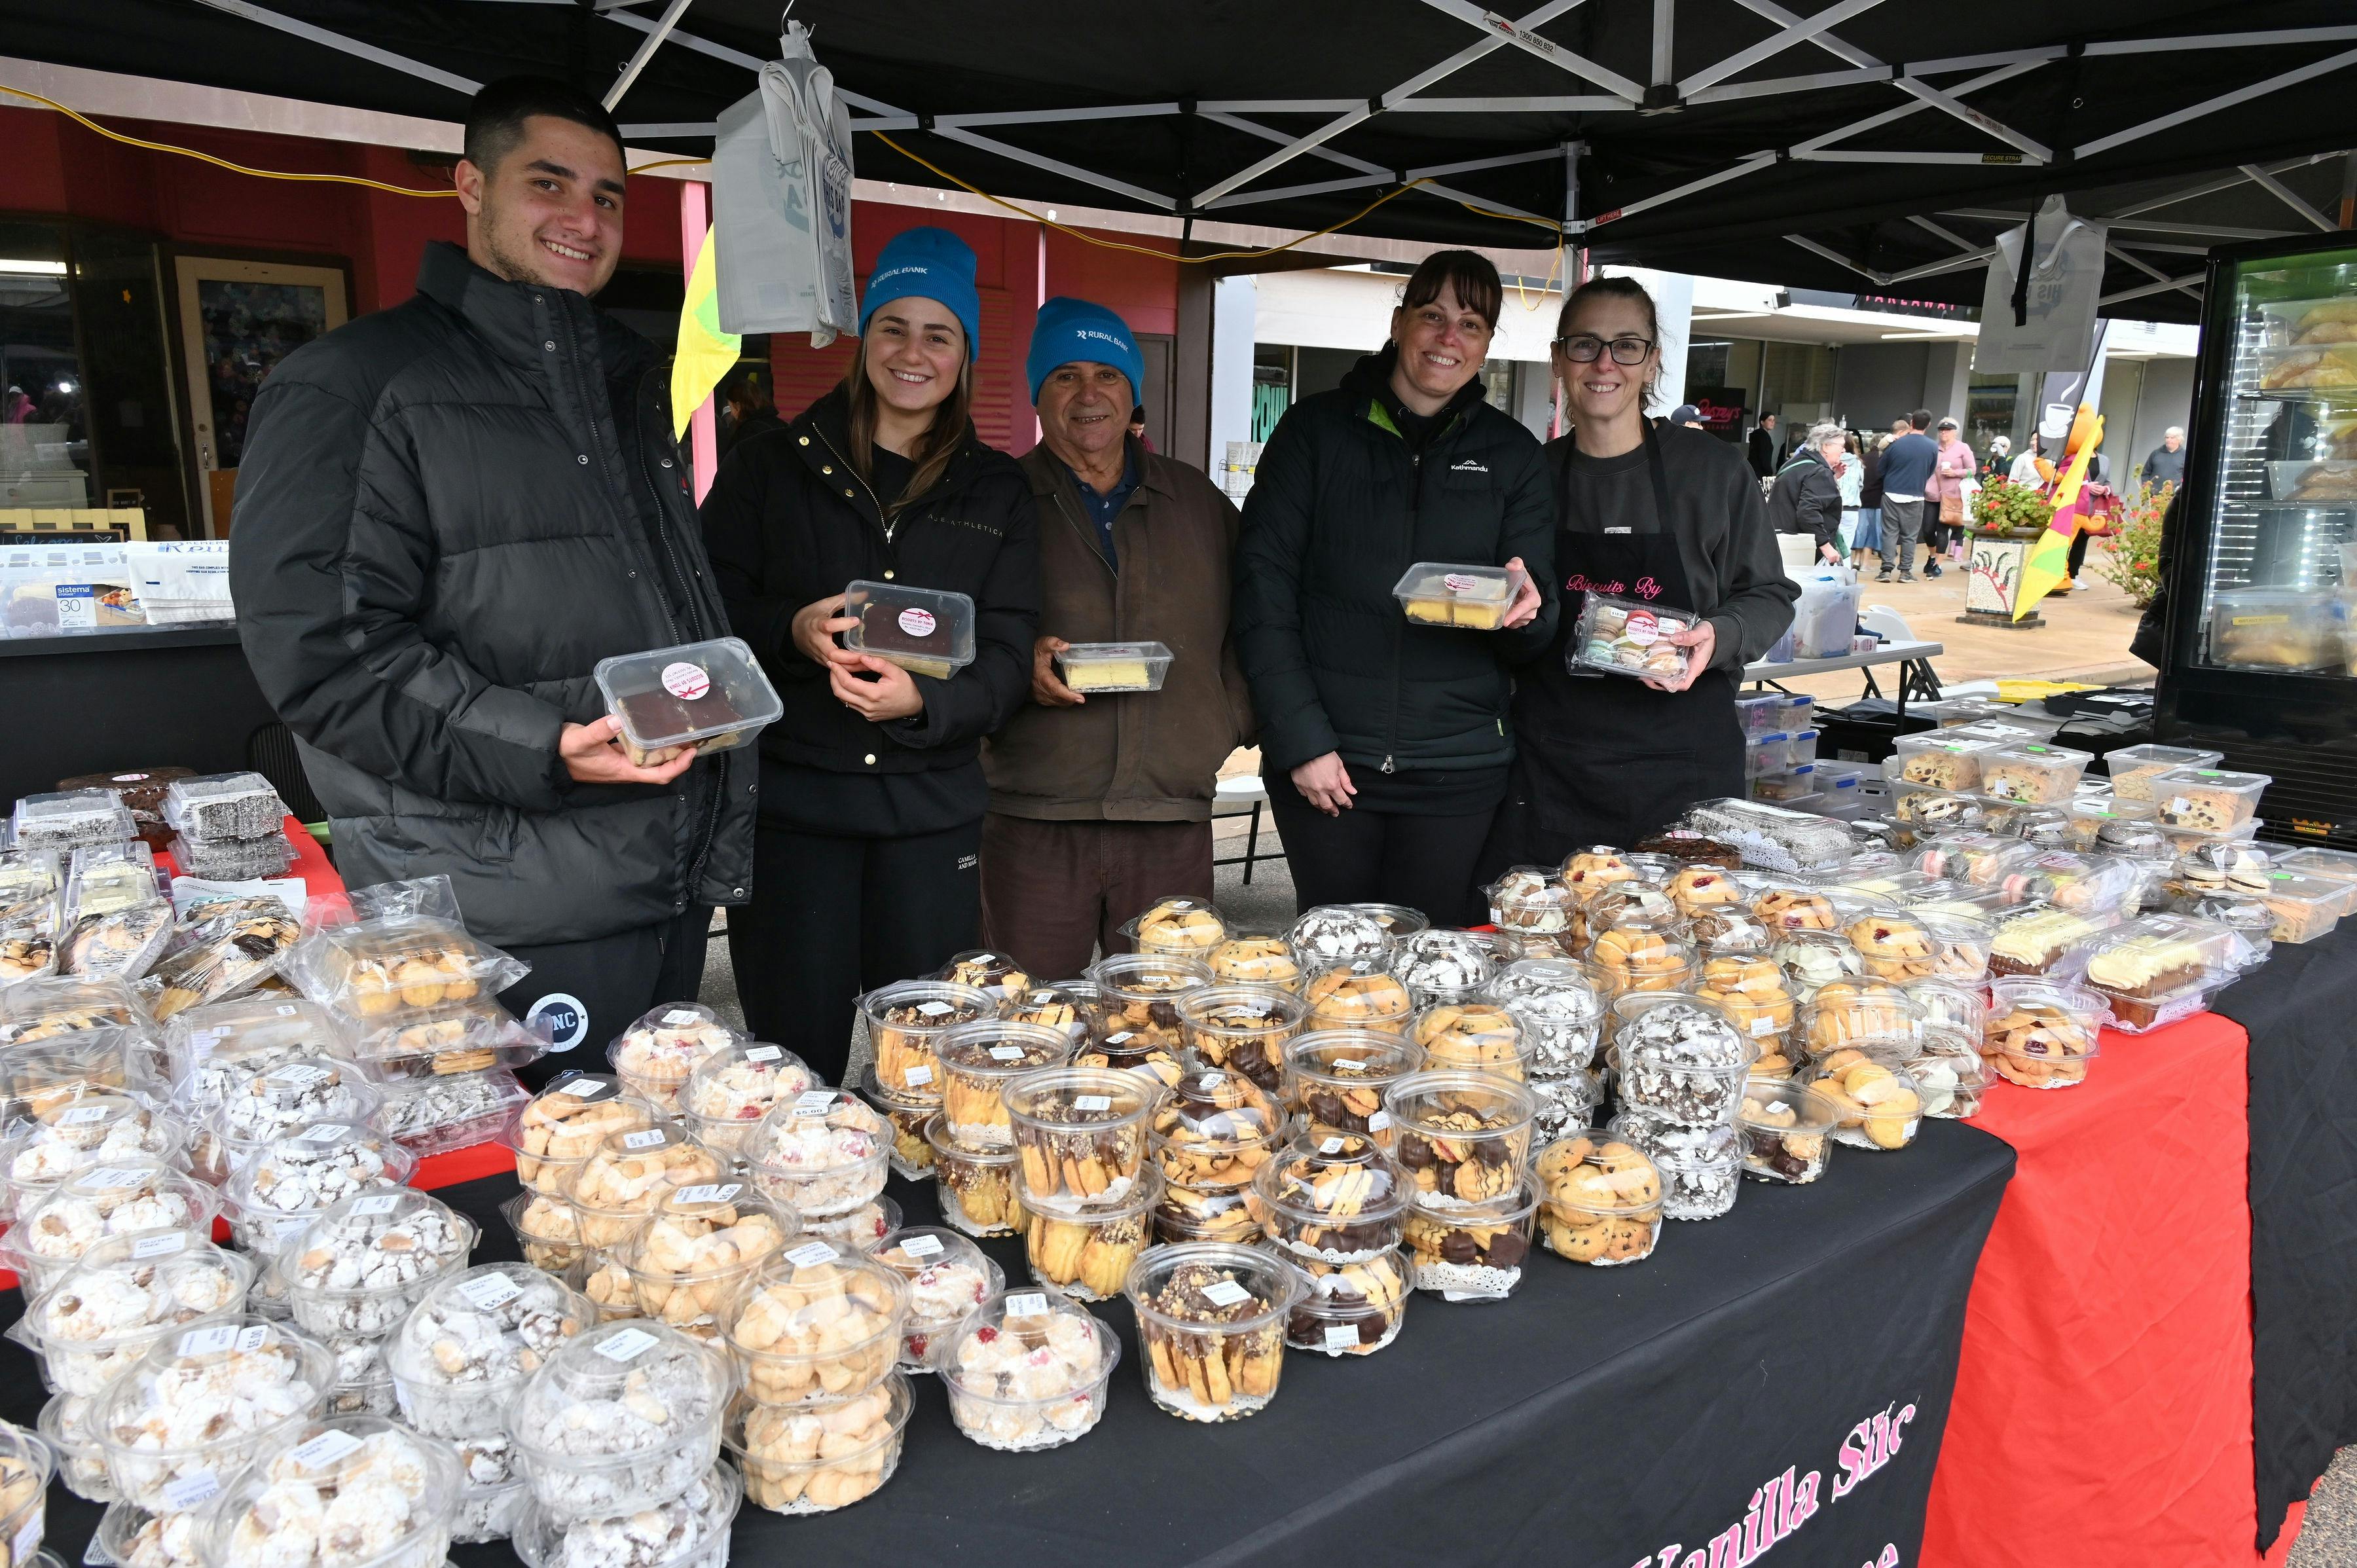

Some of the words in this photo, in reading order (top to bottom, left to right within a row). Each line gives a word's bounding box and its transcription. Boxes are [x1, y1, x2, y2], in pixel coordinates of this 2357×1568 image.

[1519, 30, 1533, 41] 1300
[1533, 36, 1543, 47] 850
[1543, 41, 1555, 52] 832
[1597, 214, 1609, 223] LIFT
[1608, 209, 1621, 219] HERE
[878, 269, 902, 282] RURAL
[1088, 331, 1114, 343] RURAL
[1113, 337, 1129, 354] BANK
[1566, 574, 1627, 593] Biscuits
[1635, 577, 1664, 600] By
[60, 599, 81, 613] 30
[484, 1290, 517, 1308] $5.00
